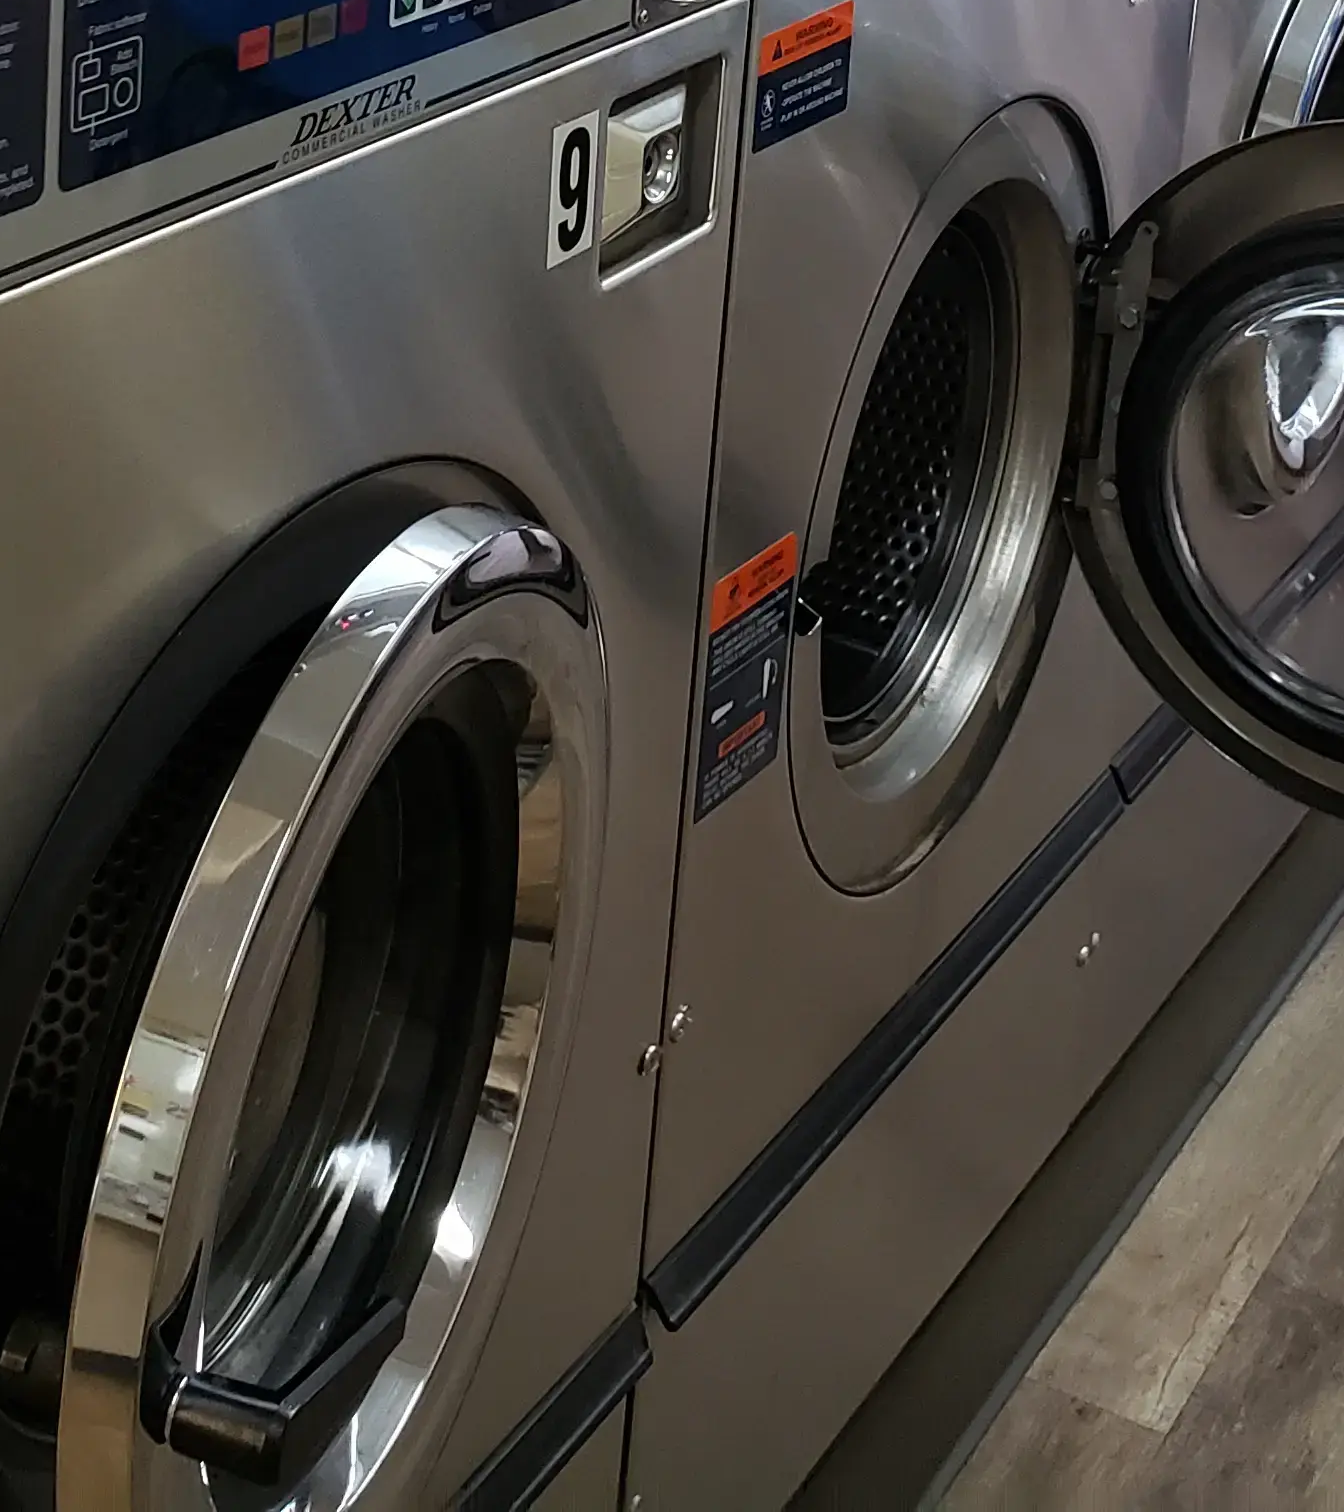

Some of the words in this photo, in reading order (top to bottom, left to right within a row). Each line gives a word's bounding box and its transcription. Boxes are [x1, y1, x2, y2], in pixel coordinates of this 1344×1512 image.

[282, 122, 365, 165] COMMERCIAL
[373, 99, 421, 128] WASHER
[290, 74, 416, 147] DEXTER
[557, 126, 590, 253] 9
